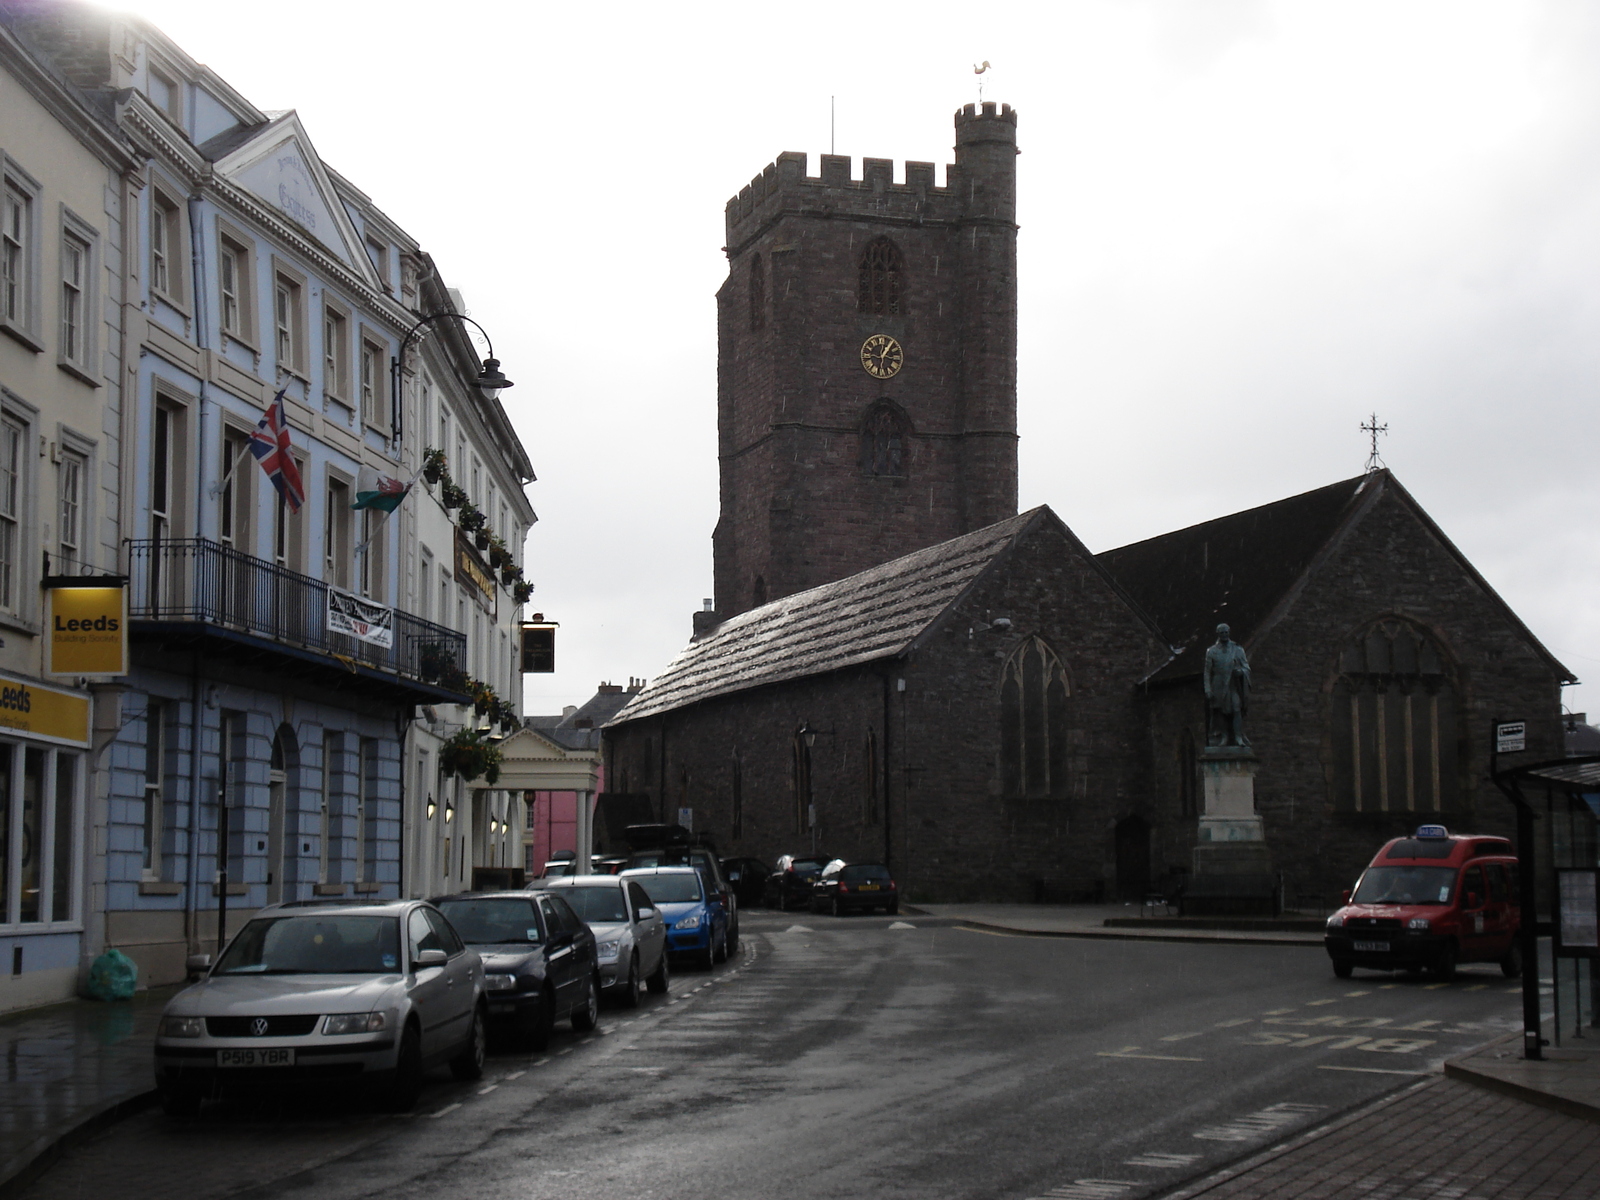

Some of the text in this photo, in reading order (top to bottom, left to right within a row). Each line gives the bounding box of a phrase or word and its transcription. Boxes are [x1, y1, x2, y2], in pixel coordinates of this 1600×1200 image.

[55, 615, 119, 632] Leeds
[55, 634, 119, 645] Building Society
[0, 684, 31, 714] eeds
[1245, 1032, 1437, 1053] BUS
[221, 1050, 289, 1065] P519 YBR
